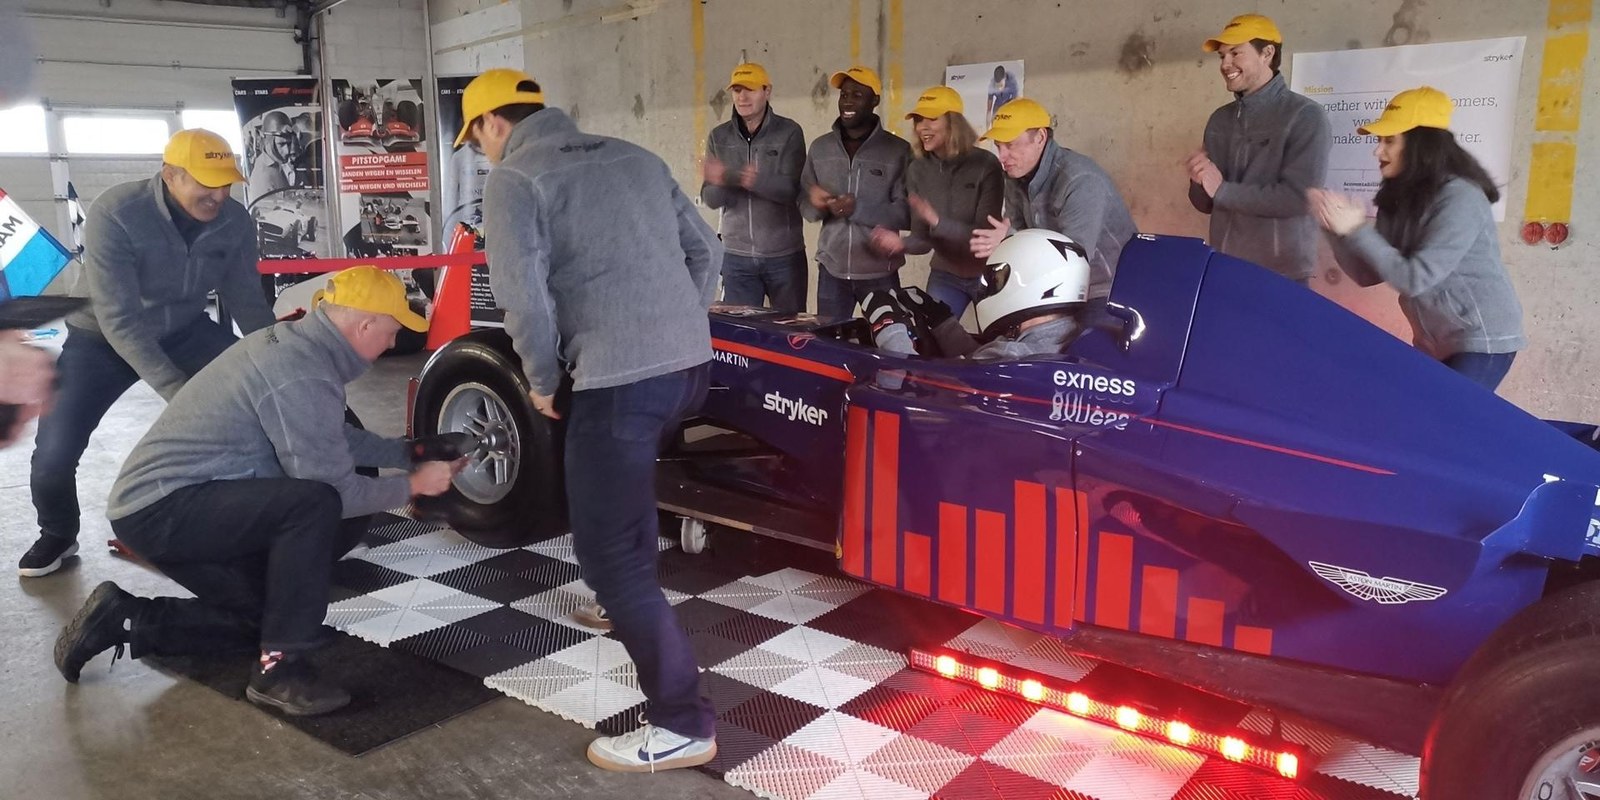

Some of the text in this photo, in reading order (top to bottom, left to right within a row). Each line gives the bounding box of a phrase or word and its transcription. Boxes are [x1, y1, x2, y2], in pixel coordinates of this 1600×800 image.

[1304, 86, 1333, 94] Mission
[1323, 99, 1360, 113] gether
[1450, 96, 1498, 108] omers,
[1459, 132, 1482, 143] ter.
[351, 155, 407, 165] PITSTOPGAME
[365, 169, 385, 177] WEGEN
[382, 182, 396, 190] UND
[397, 181, 427, 189] WECHSELN
[712, 350, 749, 369] MARTIN
[1053, 369, 1136, 396] exness
[763, 391, 828, 426] stryker
[1348, 575, 1402, 592] ASTON MARTIN
